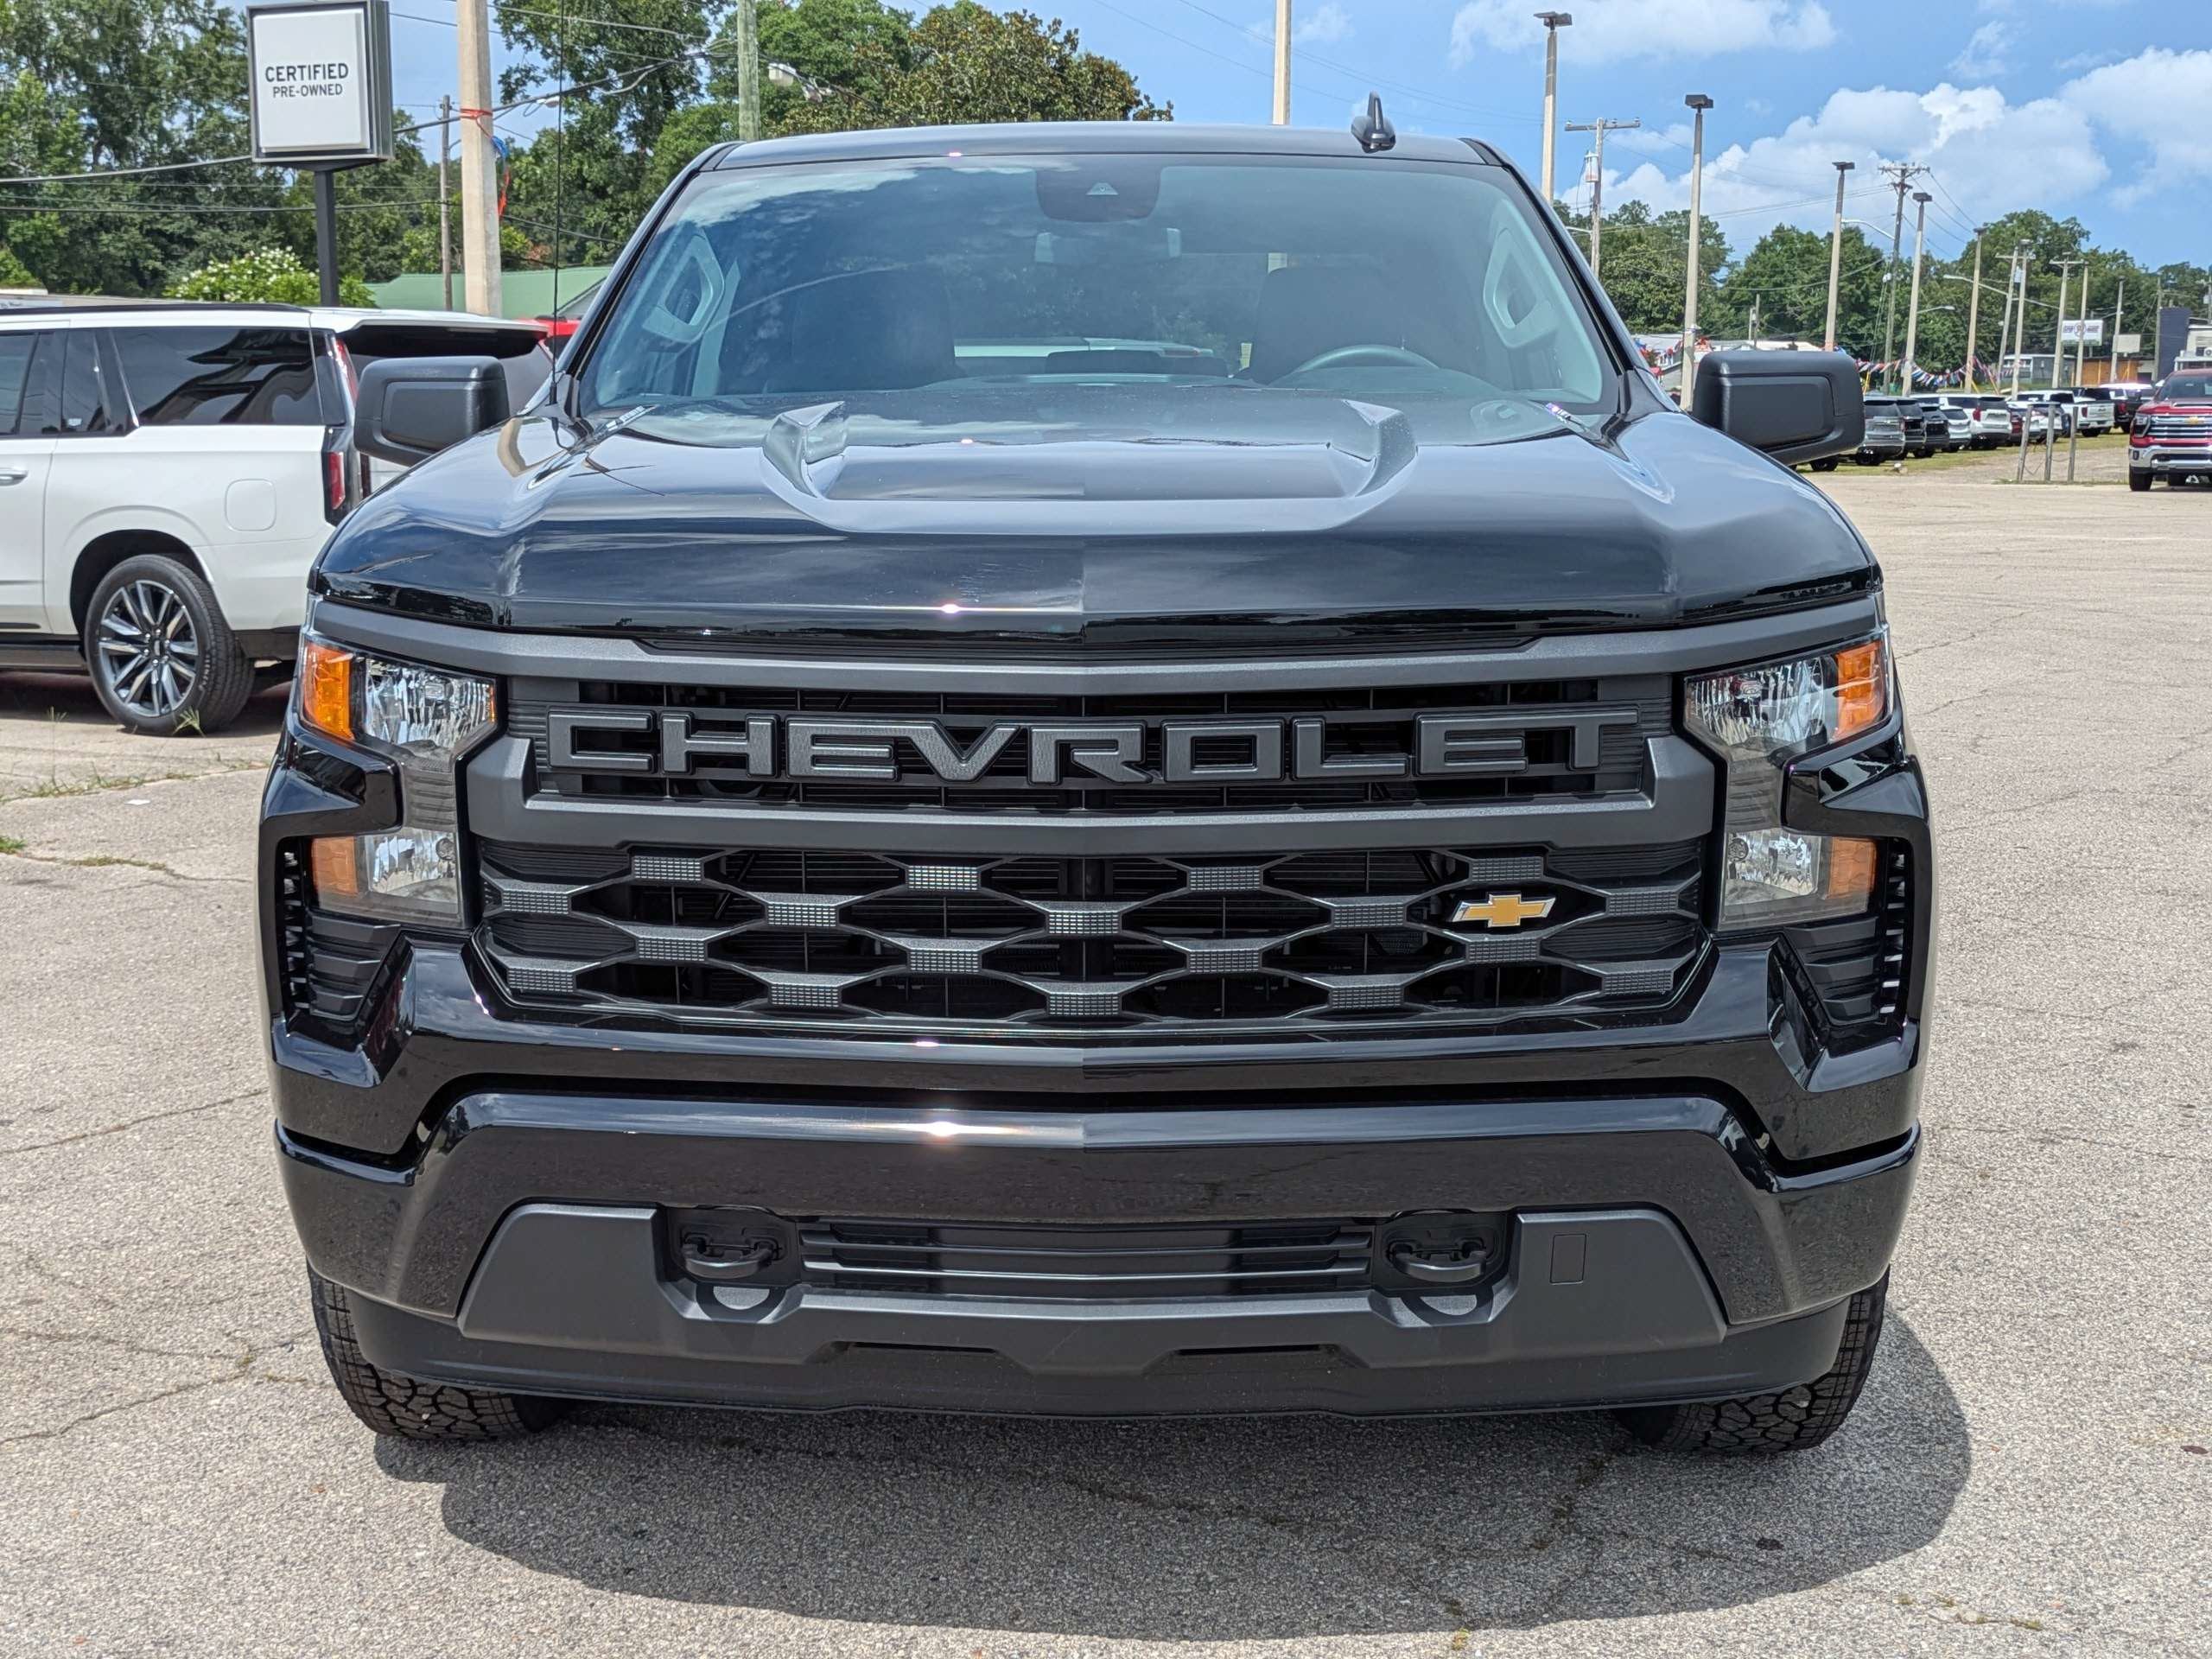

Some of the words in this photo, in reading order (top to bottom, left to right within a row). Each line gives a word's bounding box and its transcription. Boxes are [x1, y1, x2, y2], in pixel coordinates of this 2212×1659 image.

[265, 63, 348, 82] CERTIFIED
[273, 84, 342, 98] PRE-OWNED
[548, 706, 1639, 785] CHEVROLET
